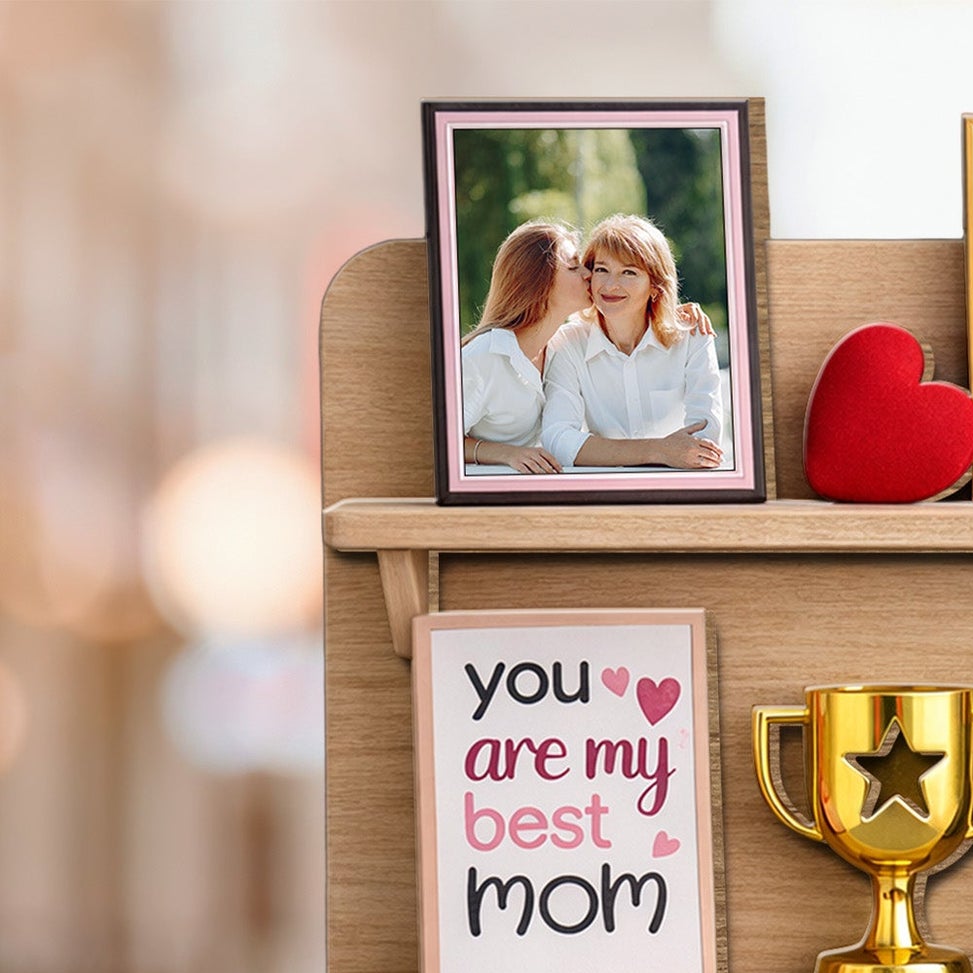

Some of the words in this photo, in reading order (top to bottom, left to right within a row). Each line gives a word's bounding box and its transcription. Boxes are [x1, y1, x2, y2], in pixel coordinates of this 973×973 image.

[464, 661, 589, 721] you
[464, 737, 570, 781] are
[586, 737, 676, 816] my
[464, 791, 612, 851] best
[467, 863, 667, 937] mom
